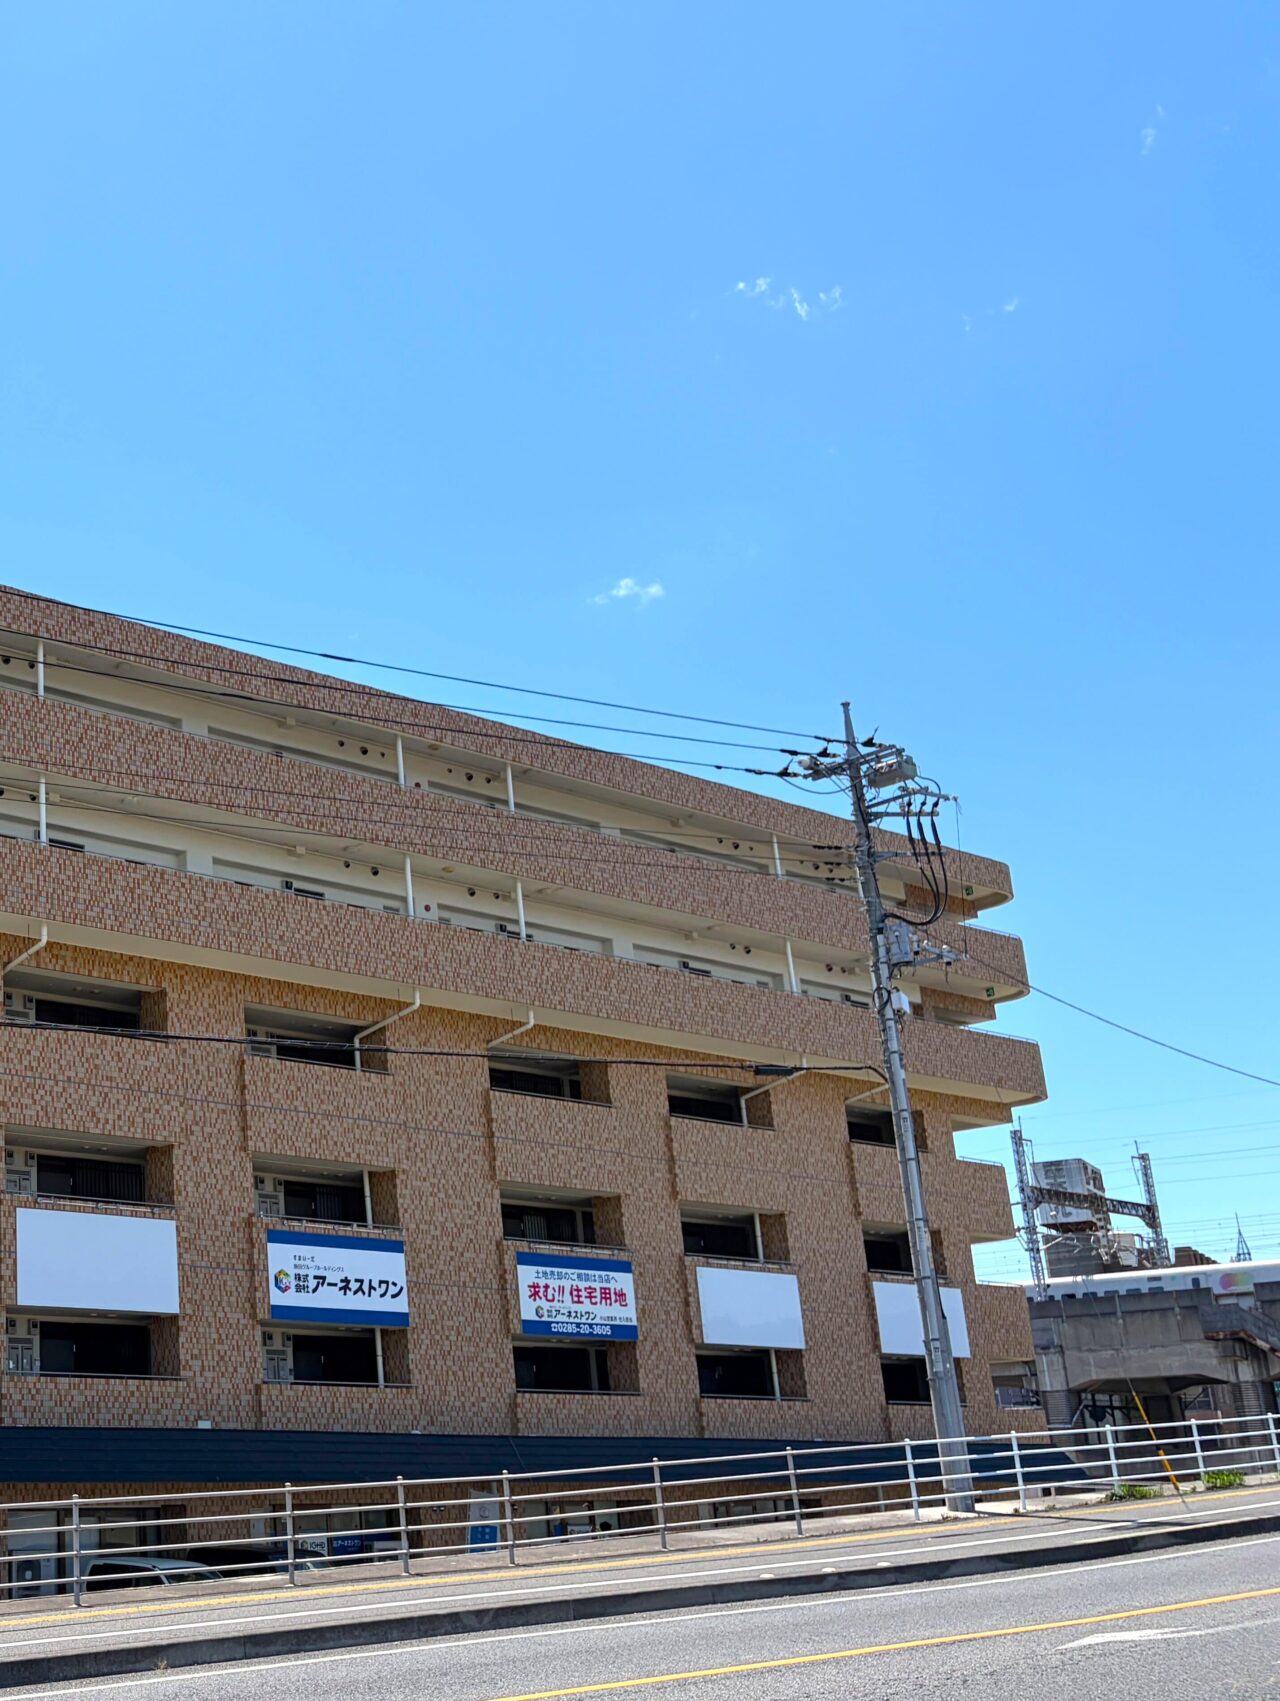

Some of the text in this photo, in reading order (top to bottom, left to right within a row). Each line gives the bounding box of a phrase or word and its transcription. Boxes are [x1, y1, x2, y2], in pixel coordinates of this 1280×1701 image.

[312, 1275, 404, 1299] アーネストワン
[569, 1284, 628, 1307] 住宅用地
